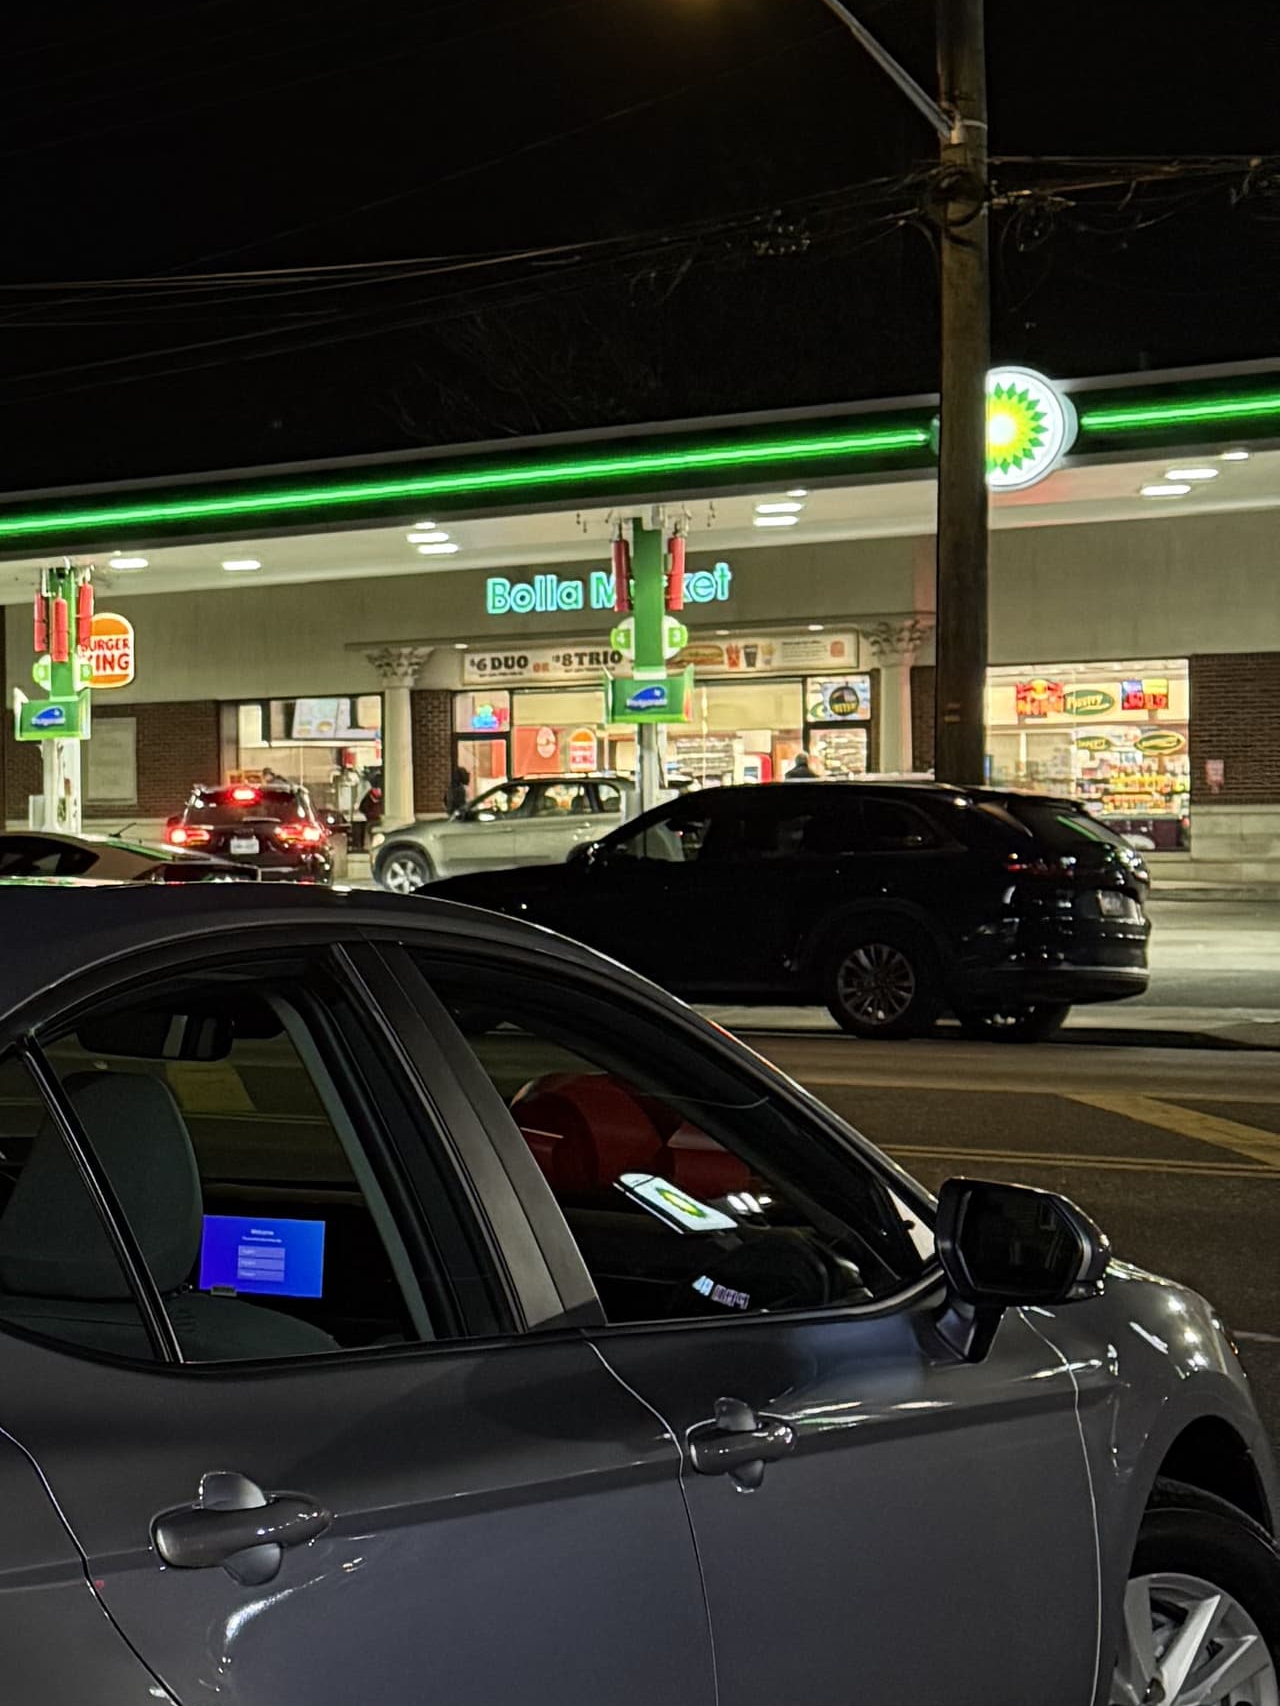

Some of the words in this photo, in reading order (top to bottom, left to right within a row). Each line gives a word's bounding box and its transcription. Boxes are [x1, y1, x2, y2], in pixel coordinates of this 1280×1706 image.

[486, 574, 584, 615] Bolla
[80, 652, 130, 673] ING
[491, 655, 529, 671] DUO
[574, 649, 623, 667] TRIO
